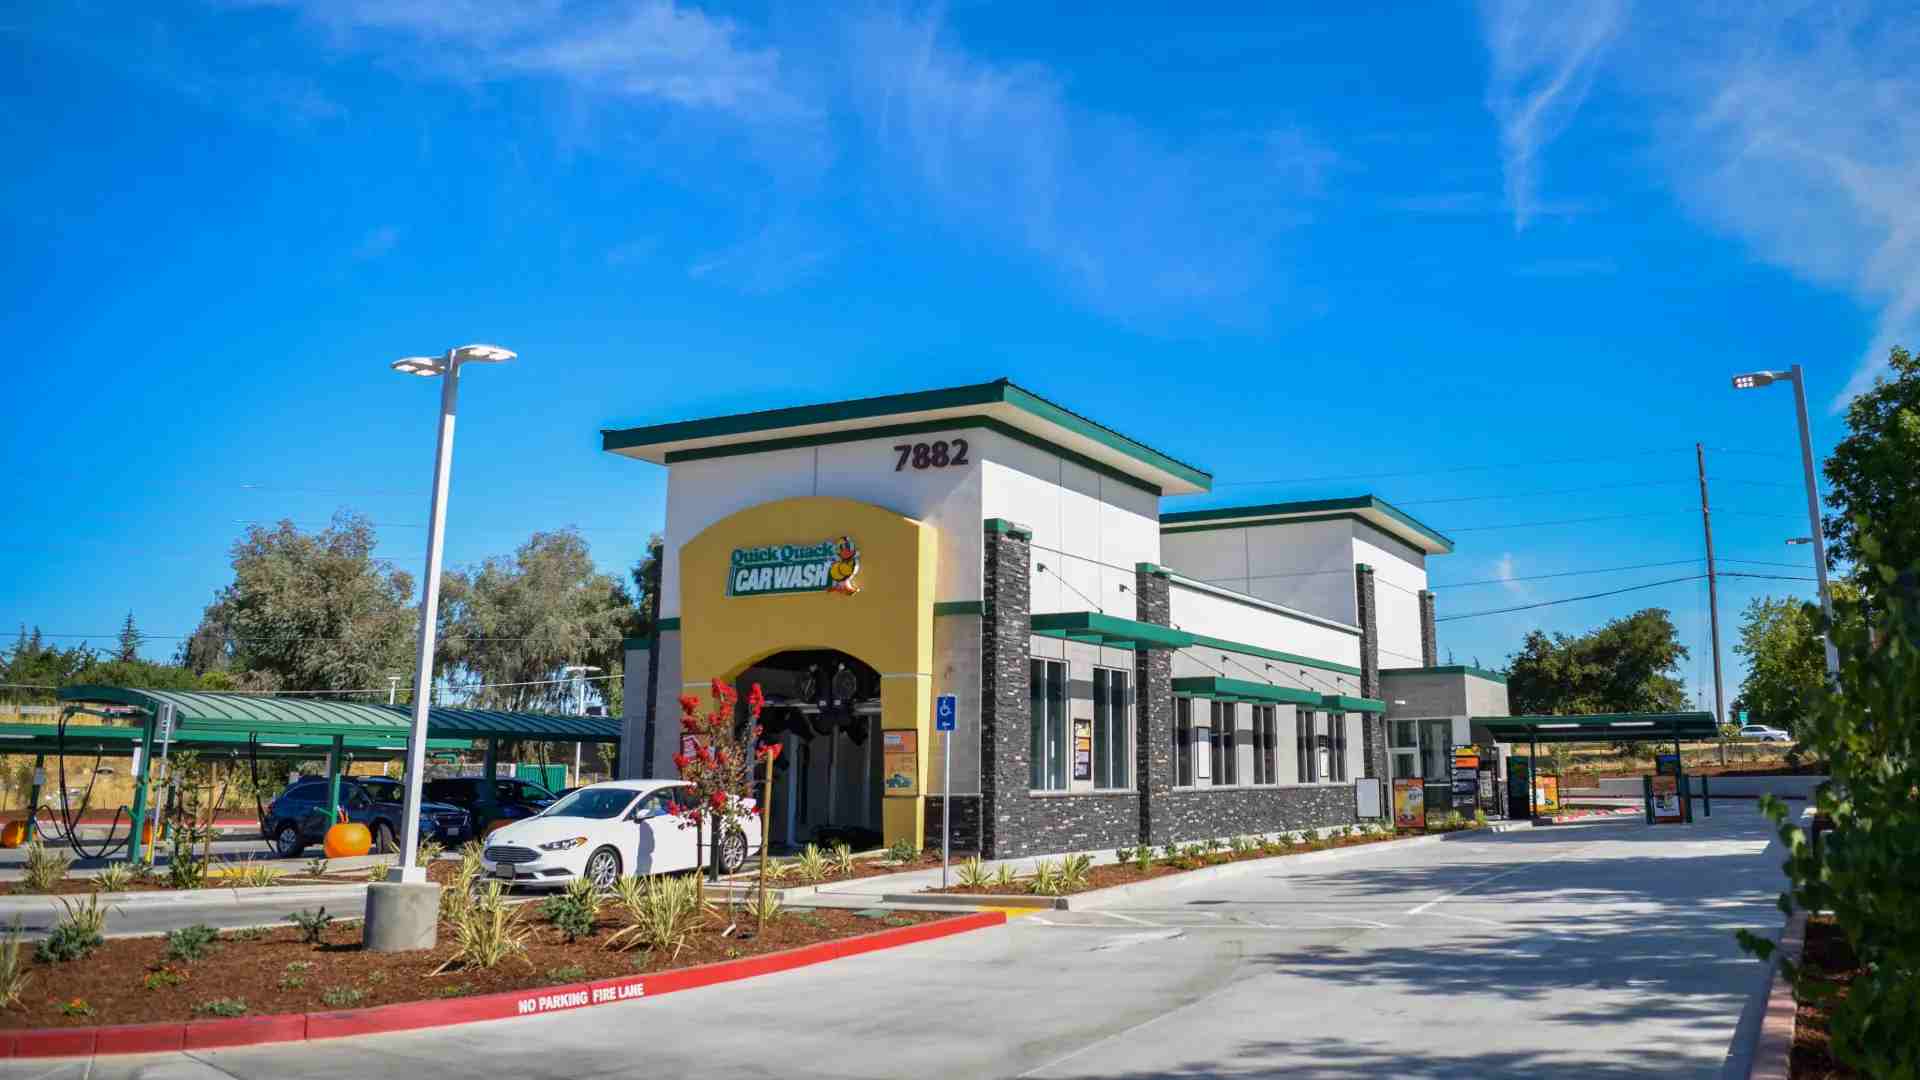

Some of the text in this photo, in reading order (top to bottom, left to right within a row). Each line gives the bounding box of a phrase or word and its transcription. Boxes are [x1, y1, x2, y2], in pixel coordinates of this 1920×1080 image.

[894, 438, 969, 471] 7882
[732, 542, 833, 562] Quick Quack
[518, 983, 645, 1014] NO PARKING FIRE LANE
